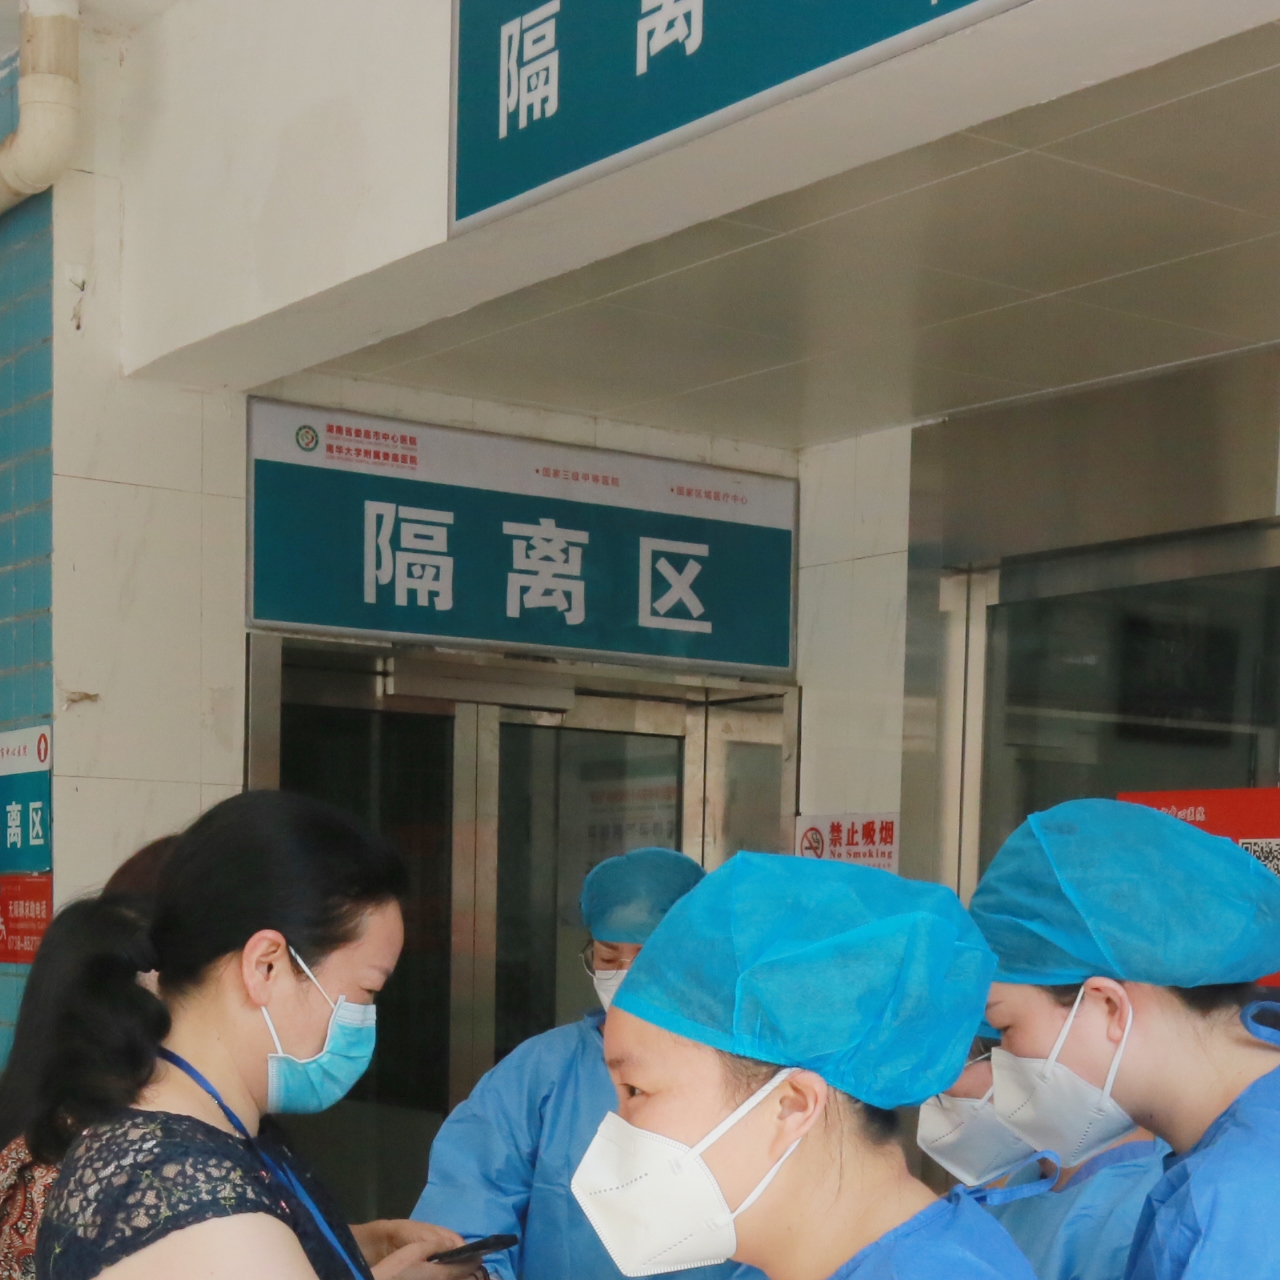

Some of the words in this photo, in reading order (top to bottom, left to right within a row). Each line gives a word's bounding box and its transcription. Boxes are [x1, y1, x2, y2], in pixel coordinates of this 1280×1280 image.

[542, 467, 619, 487] 国家三级甲等医院
[363, 499, 712, 634] 隔离区
[829, 821, 894, 848] 禁止吸烟
[829, 849, 842, 859] No
[846, 848, 893, 859] Smoking
